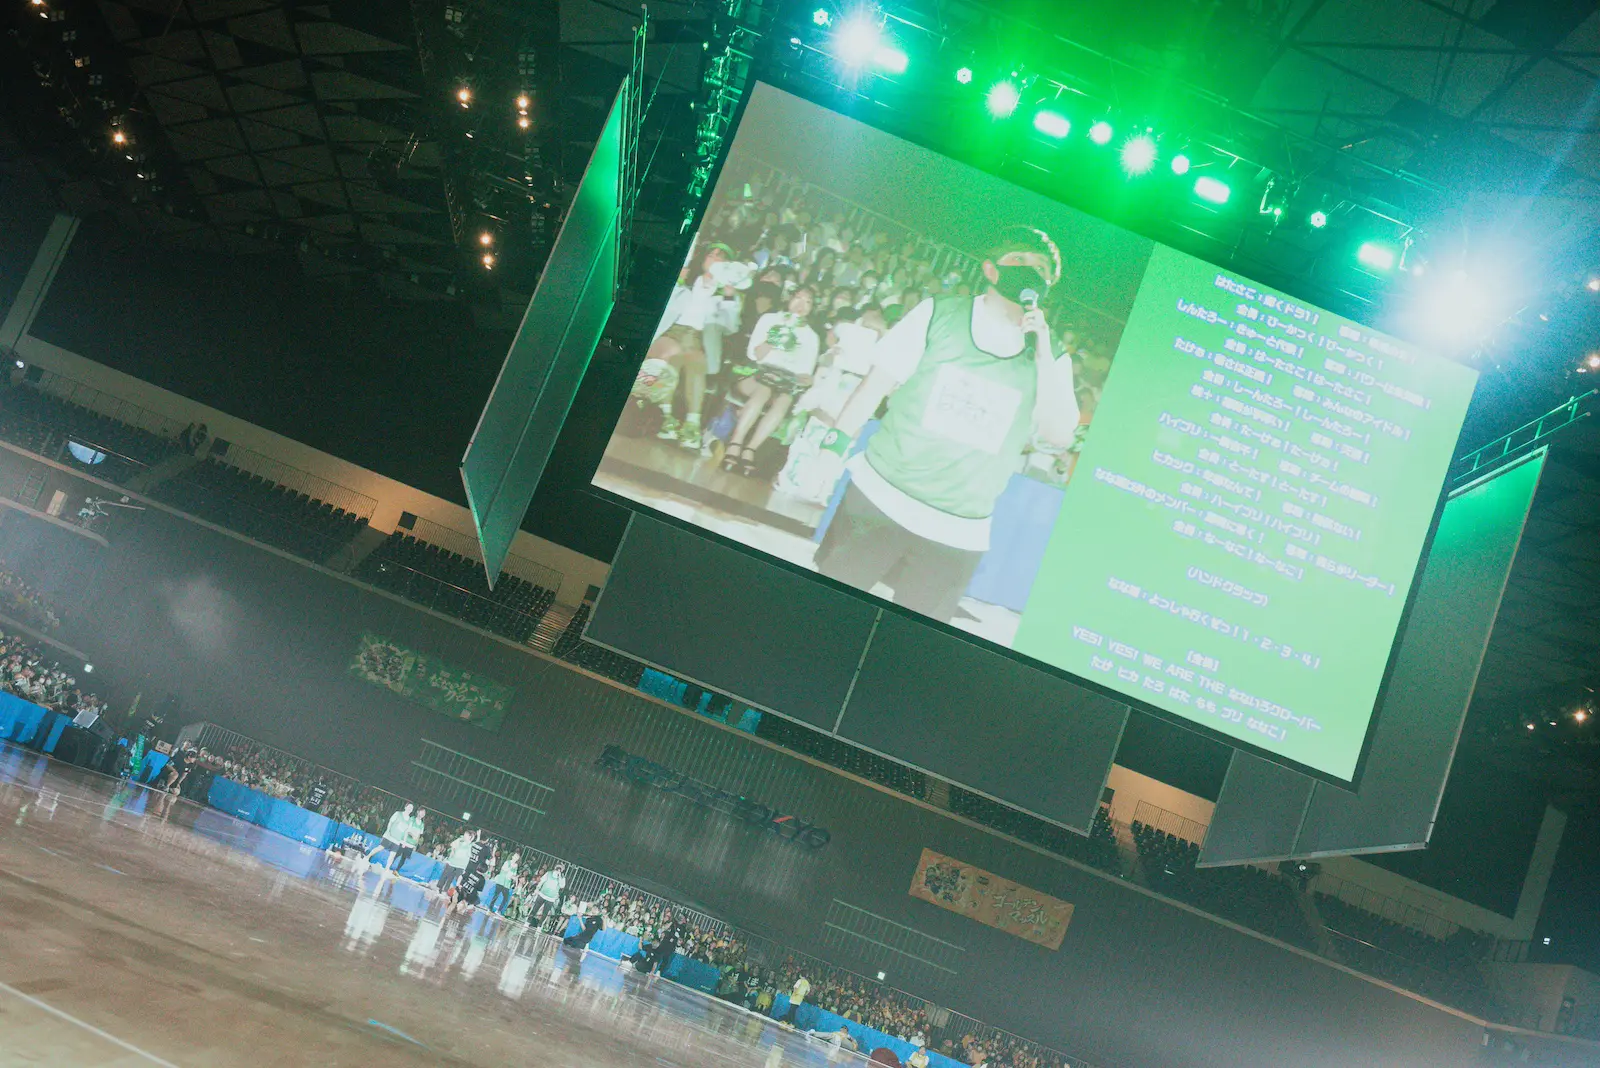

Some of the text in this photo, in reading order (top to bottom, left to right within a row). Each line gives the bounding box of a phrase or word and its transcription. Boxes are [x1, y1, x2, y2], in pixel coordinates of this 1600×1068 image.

[1141, 652, 1163, 670] WE
[1164, 662, 1195, 682] ARE
[1198, 674, 1226, 695] THE
